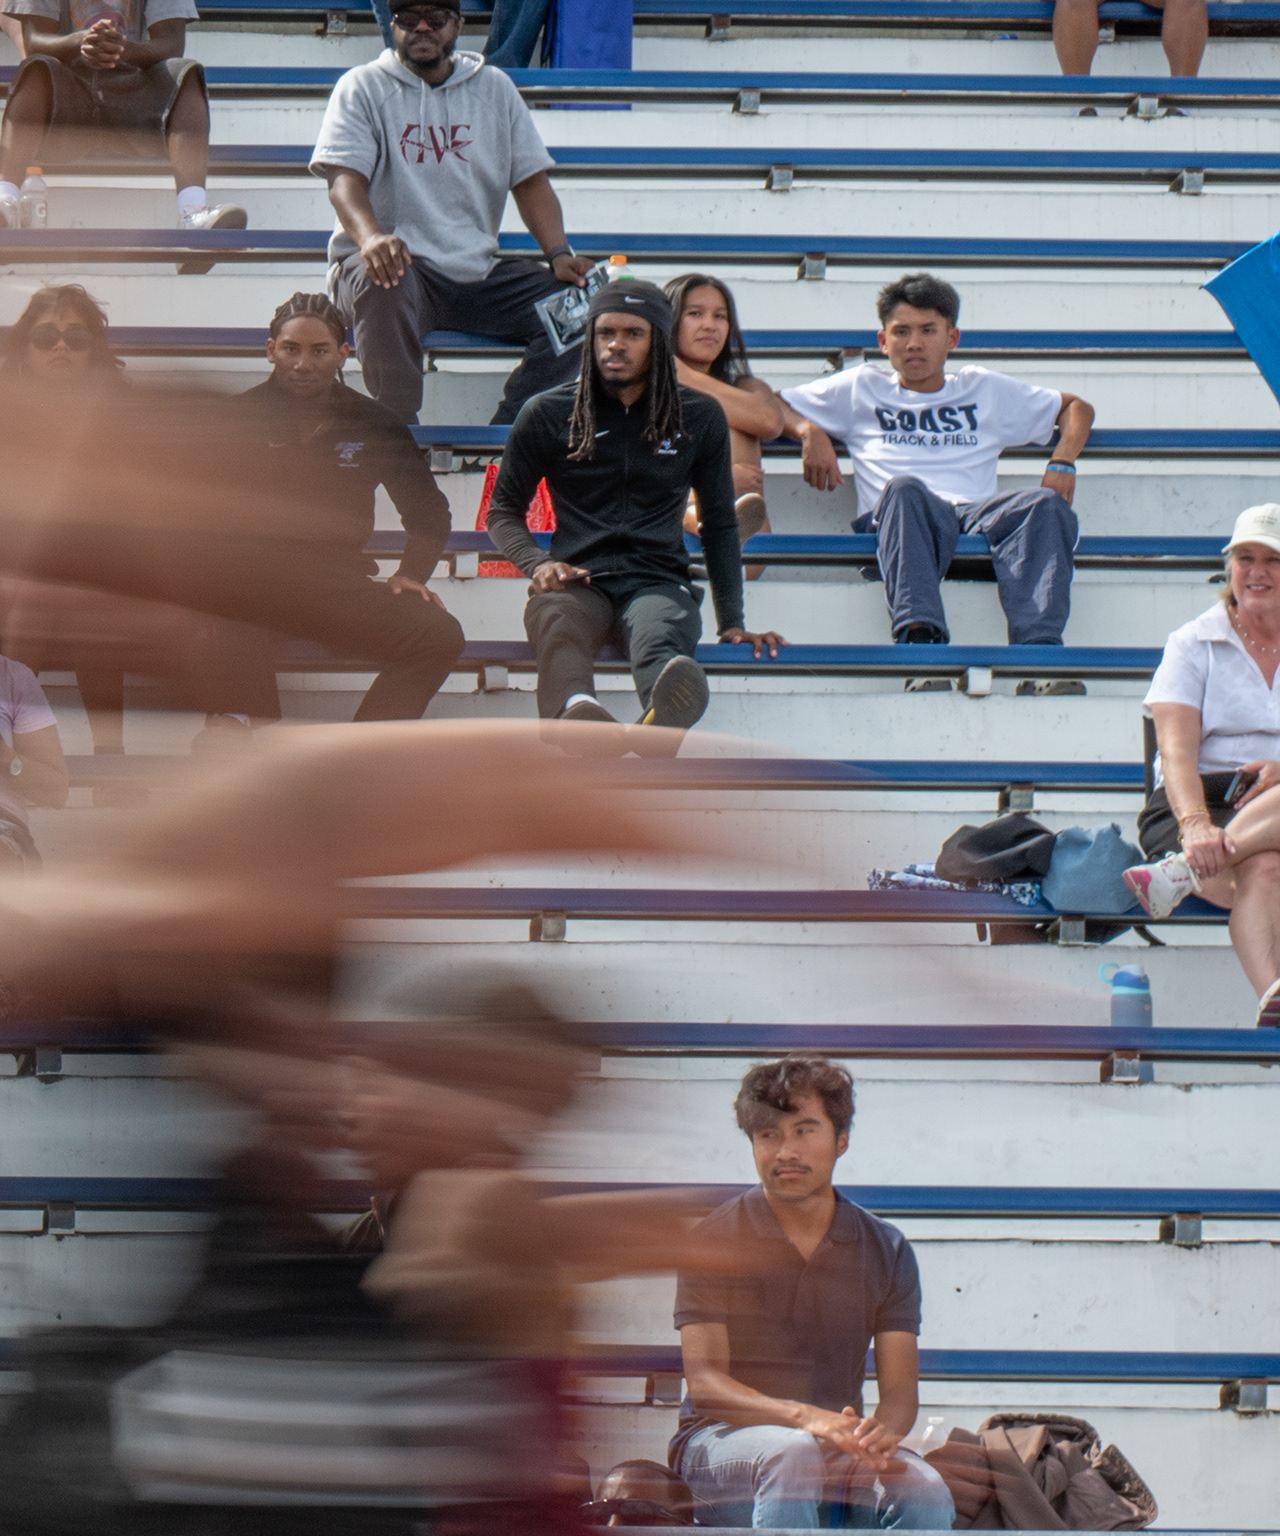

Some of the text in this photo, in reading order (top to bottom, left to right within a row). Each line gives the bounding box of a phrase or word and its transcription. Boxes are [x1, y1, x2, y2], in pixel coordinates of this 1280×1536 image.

[874, 403, 978, 433] COAST
[881, 433, 978, 446] TRACK & FIELD
